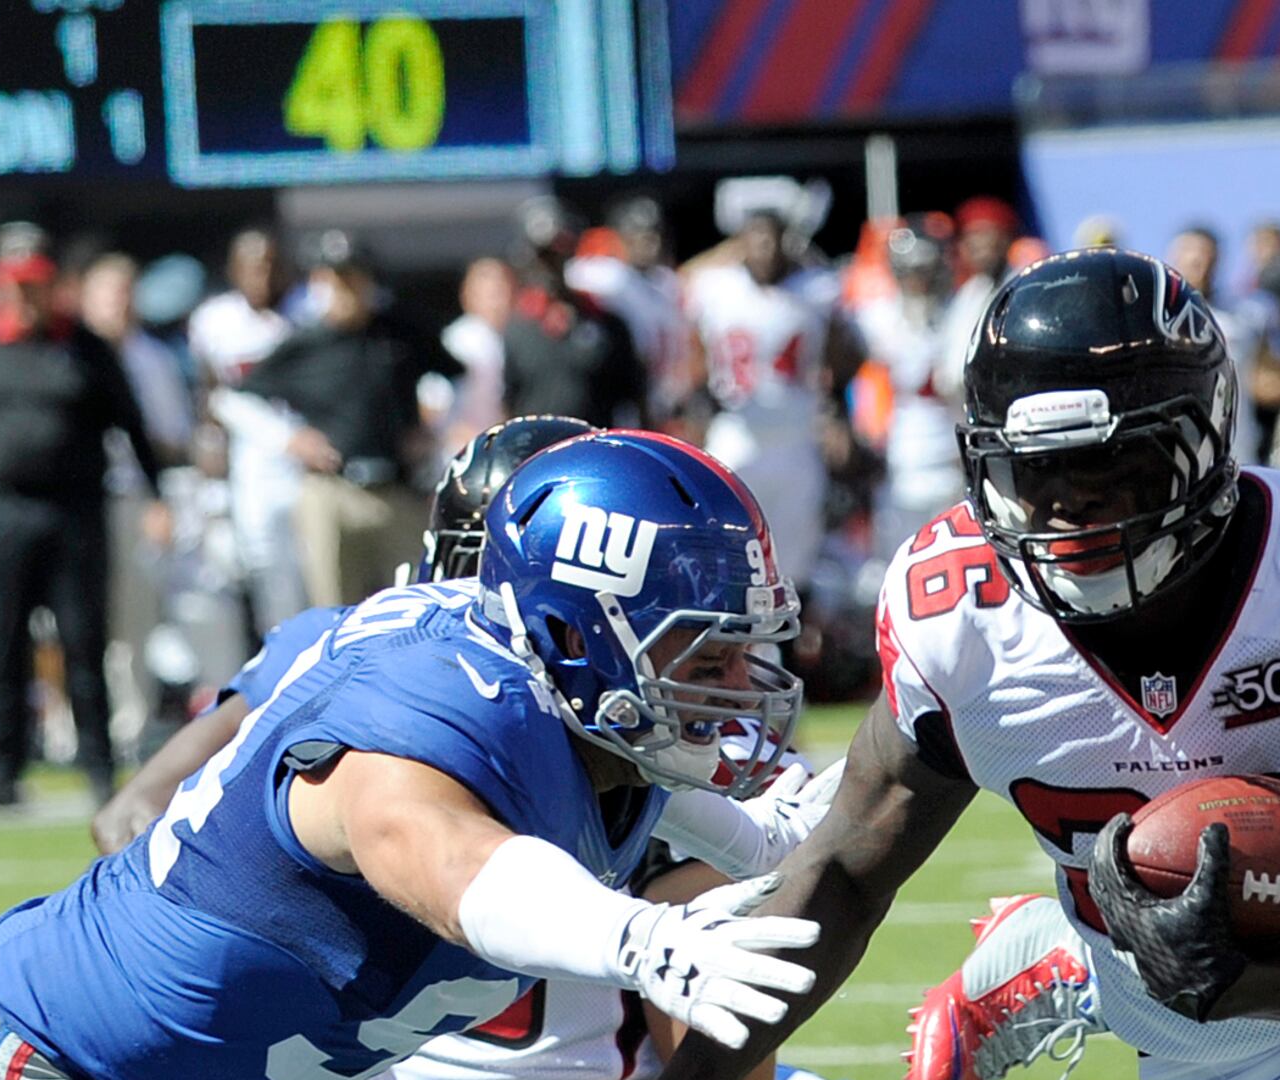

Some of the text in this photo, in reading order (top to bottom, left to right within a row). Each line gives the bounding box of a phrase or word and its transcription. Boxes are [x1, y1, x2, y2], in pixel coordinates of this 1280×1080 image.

[283, 15, 445, 152] 40
[1031, 402, 1083, 413] FALCONS
[907, 503, 1010, 621] 26
[1113, 755, 1224, 773] FALCONS
